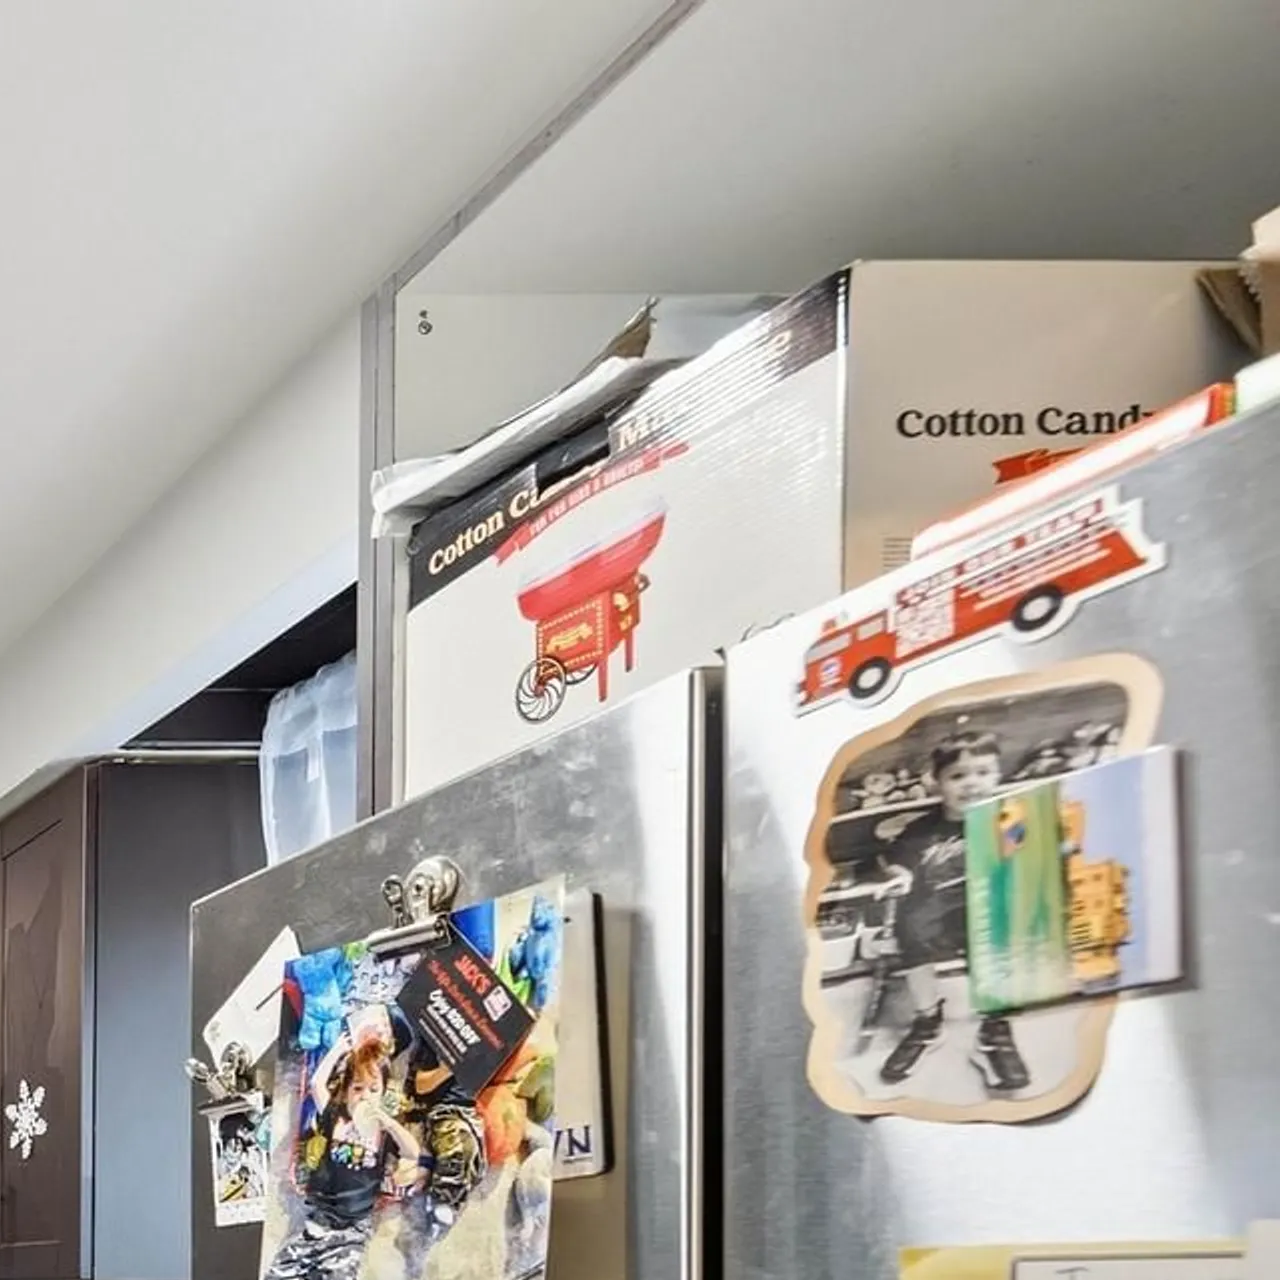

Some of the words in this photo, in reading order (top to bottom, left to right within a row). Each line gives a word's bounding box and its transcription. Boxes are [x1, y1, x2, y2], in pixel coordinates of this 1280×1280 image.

[896, 407, 1025, 438] Cotton
[1037, 404, 1155, 435] Cand
[428, 511, 504, 575] Cotton
